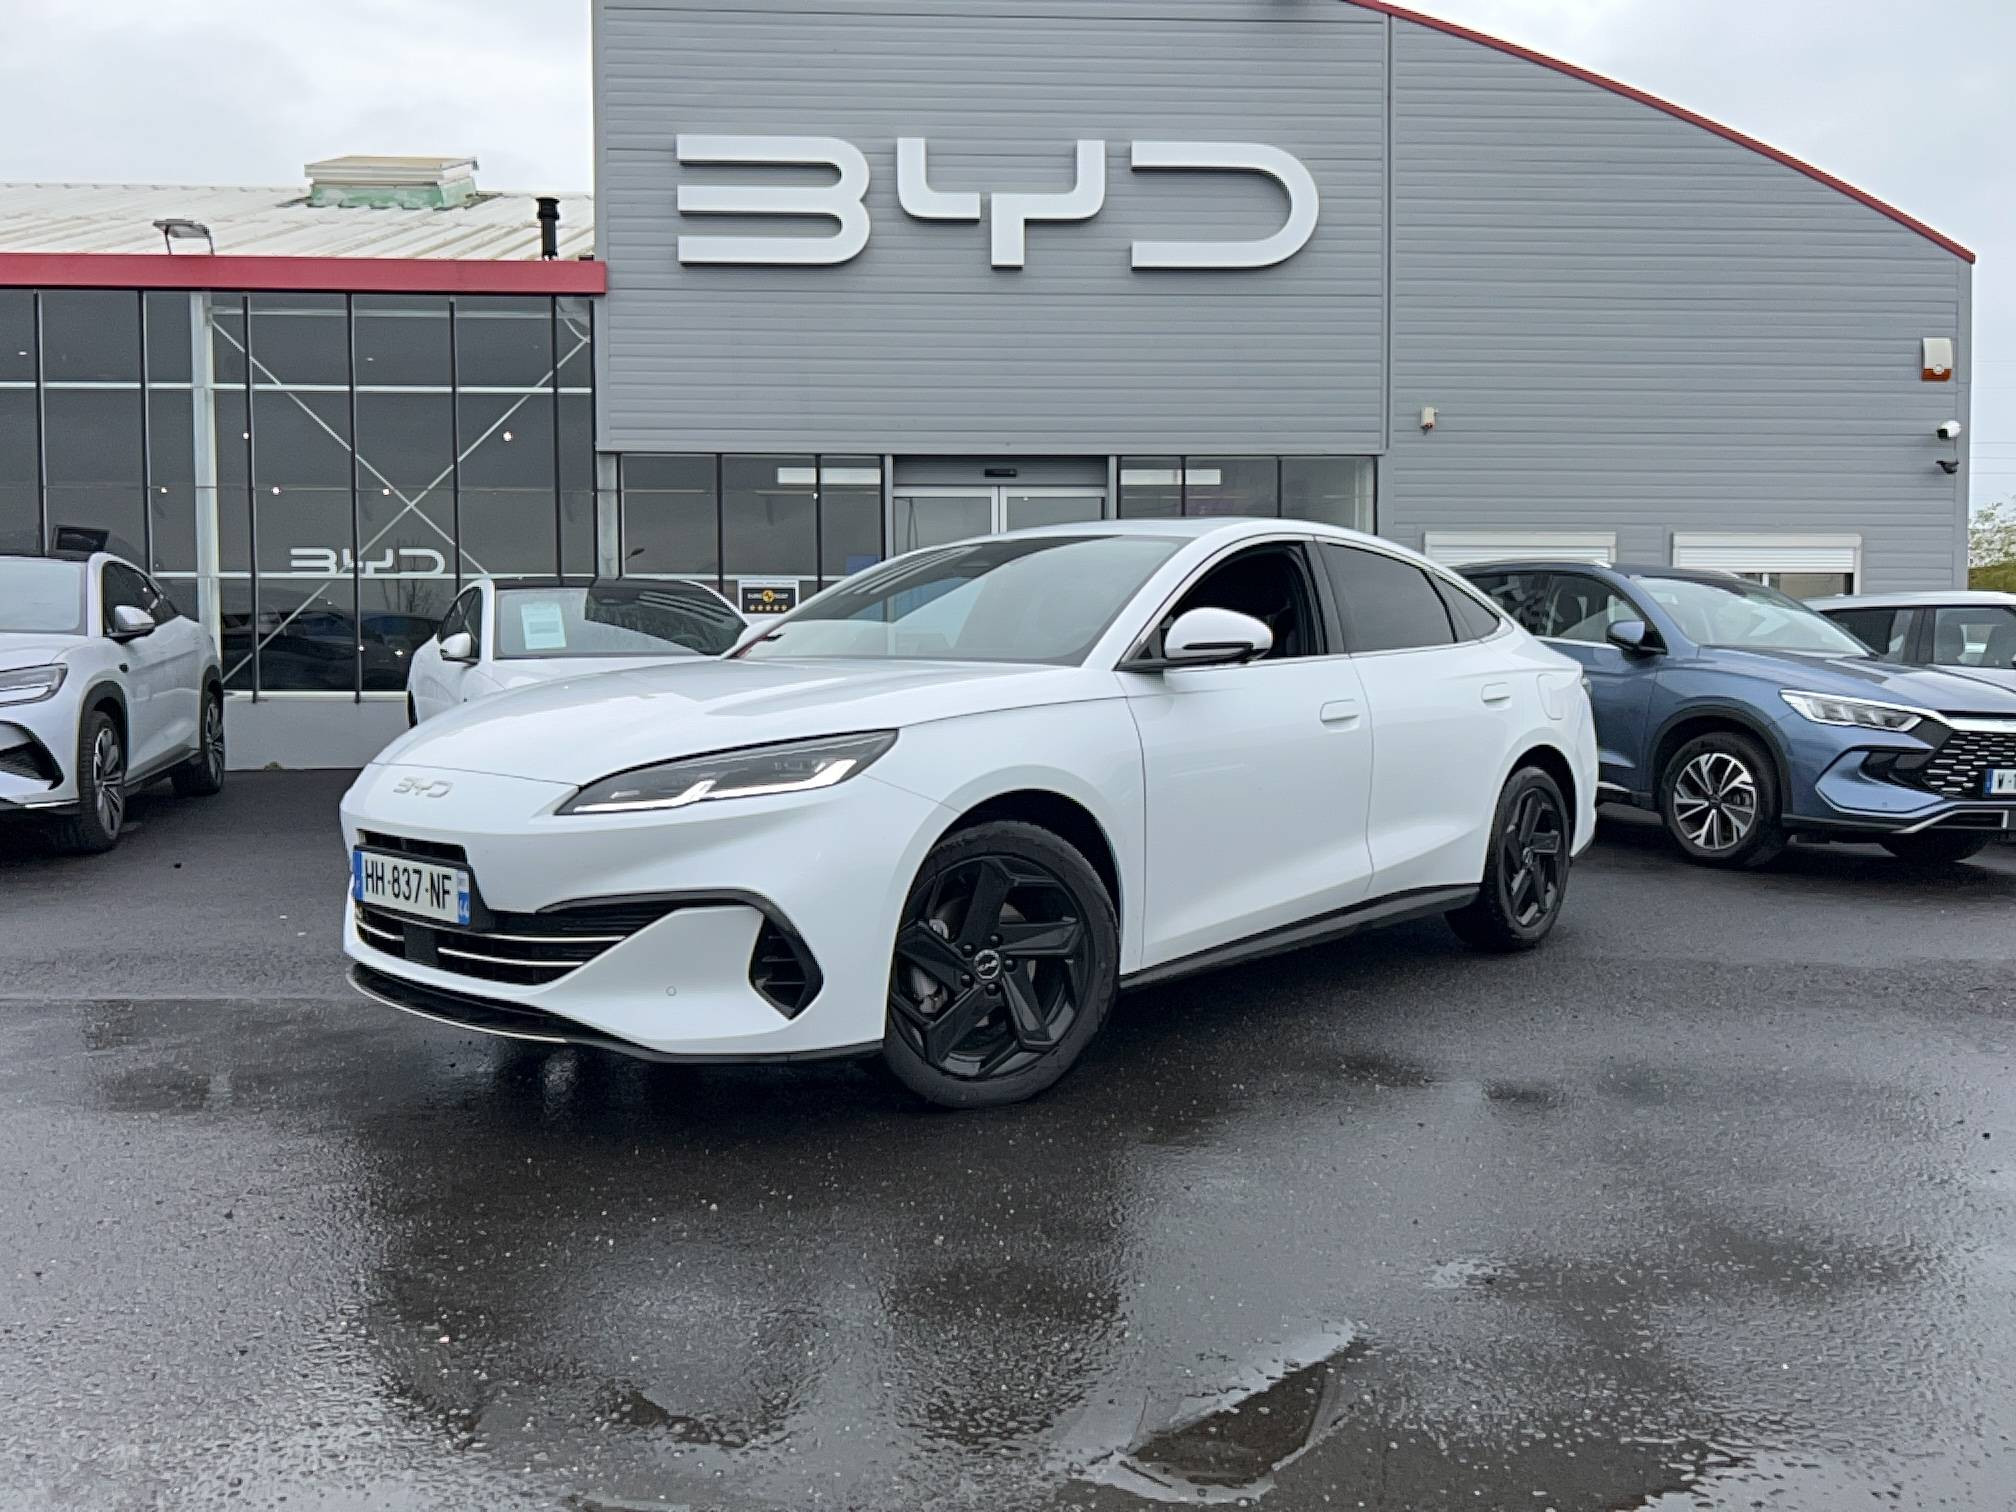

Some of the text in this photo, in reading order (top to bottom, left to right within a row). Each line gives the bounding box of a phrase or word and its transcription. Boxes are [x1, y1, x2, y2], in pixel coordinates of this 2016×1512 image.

[677, 134, 1320, 269] BYD
[290, 548, 446, 578] BYD
[393, 776, 453, 798] BYD
[364, 858, 452, 910] HH-837-NF
